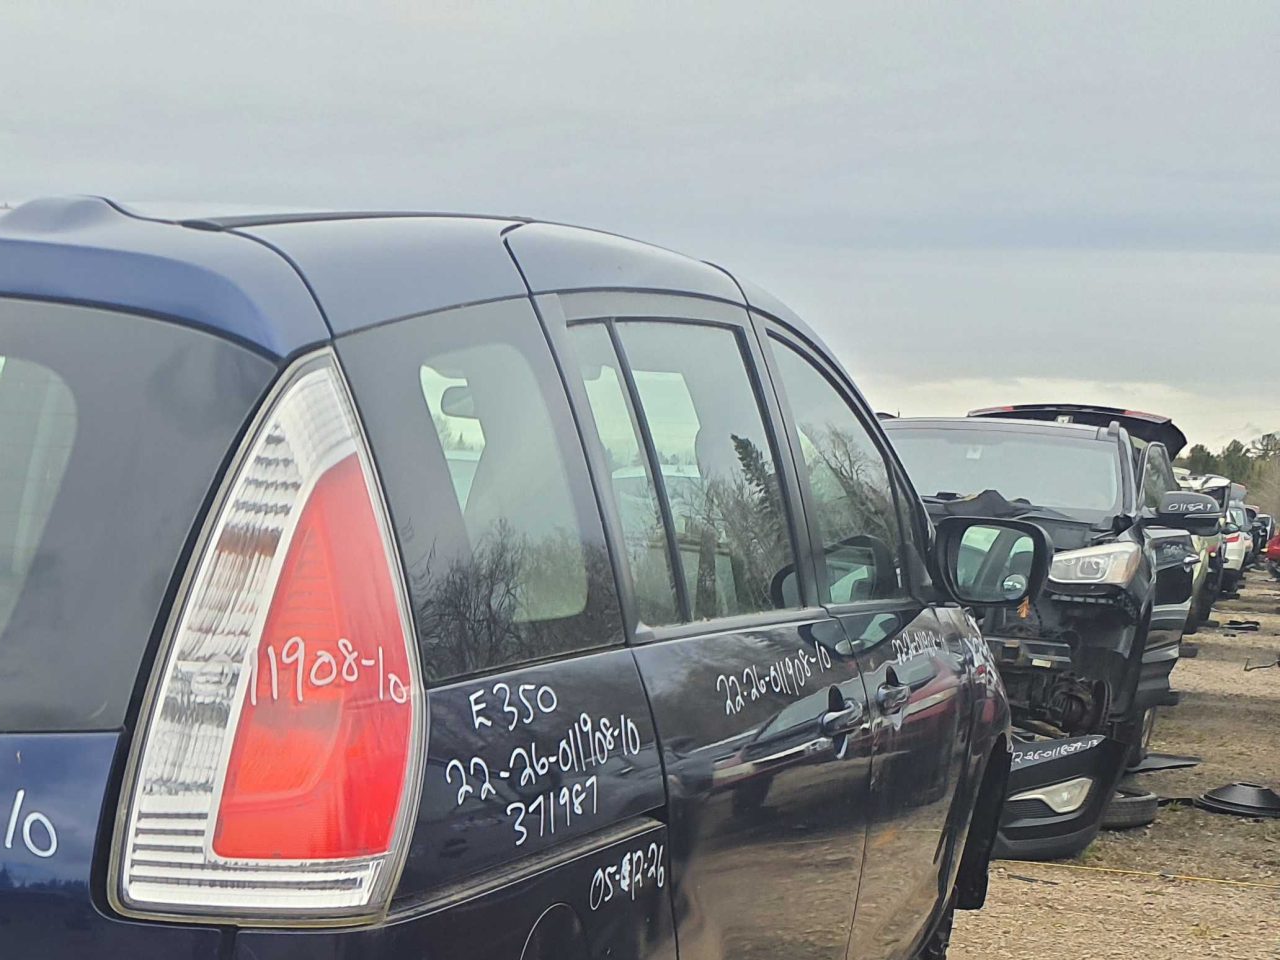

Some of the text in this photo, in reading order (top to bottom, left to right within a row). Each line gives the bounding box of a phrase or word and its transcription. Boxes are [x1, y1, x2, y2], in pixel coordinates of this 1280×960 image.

[469, 683, 557, 731] E350
[716, 644, 831, 715] 22-26-011908-10
[446, 713, 640, 806] 22-26-011908-10
[506, 775, 597, 846] 371987
